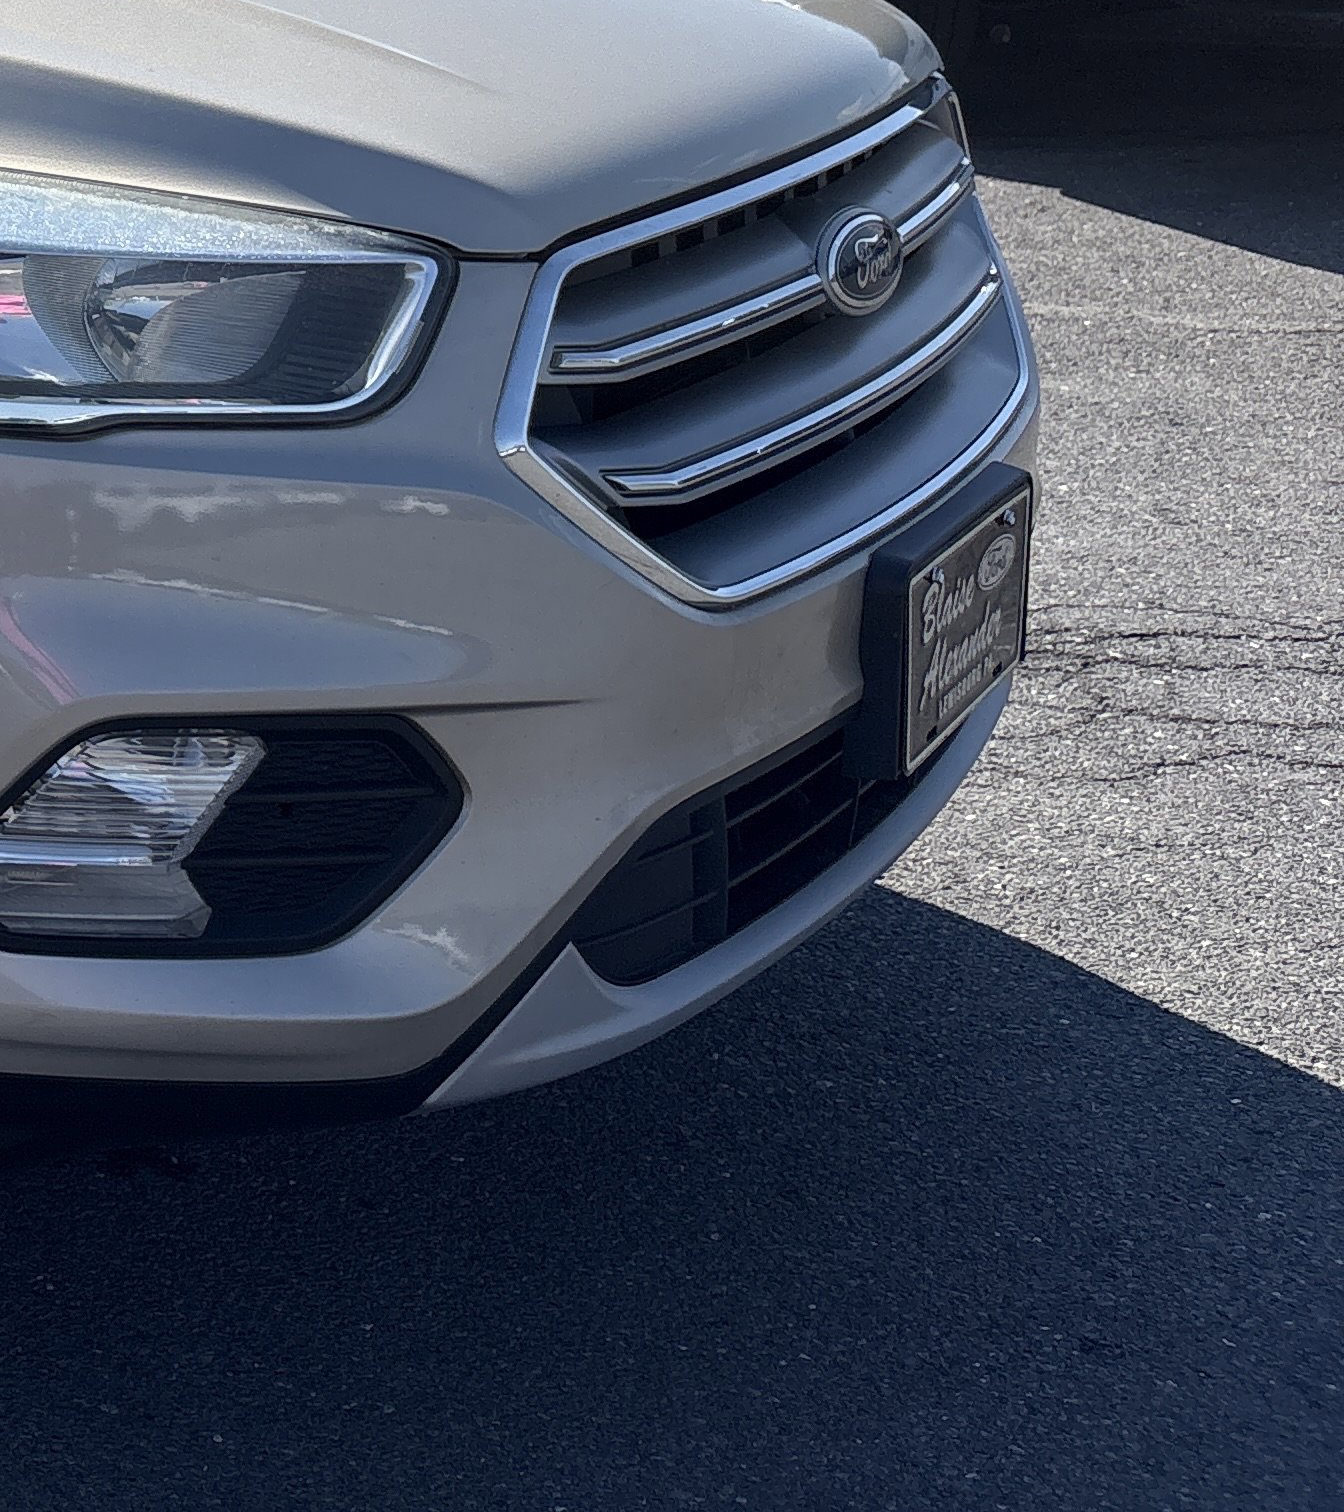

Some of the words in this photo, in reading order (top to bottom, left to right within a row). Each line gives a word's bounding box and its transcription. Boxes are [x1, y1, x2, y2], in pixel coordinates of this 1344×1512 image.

[853, 233, 889, 289] Ford
[922, 574, 975, 644] Blaise
[919, 600, 1002, 712] Alexander
